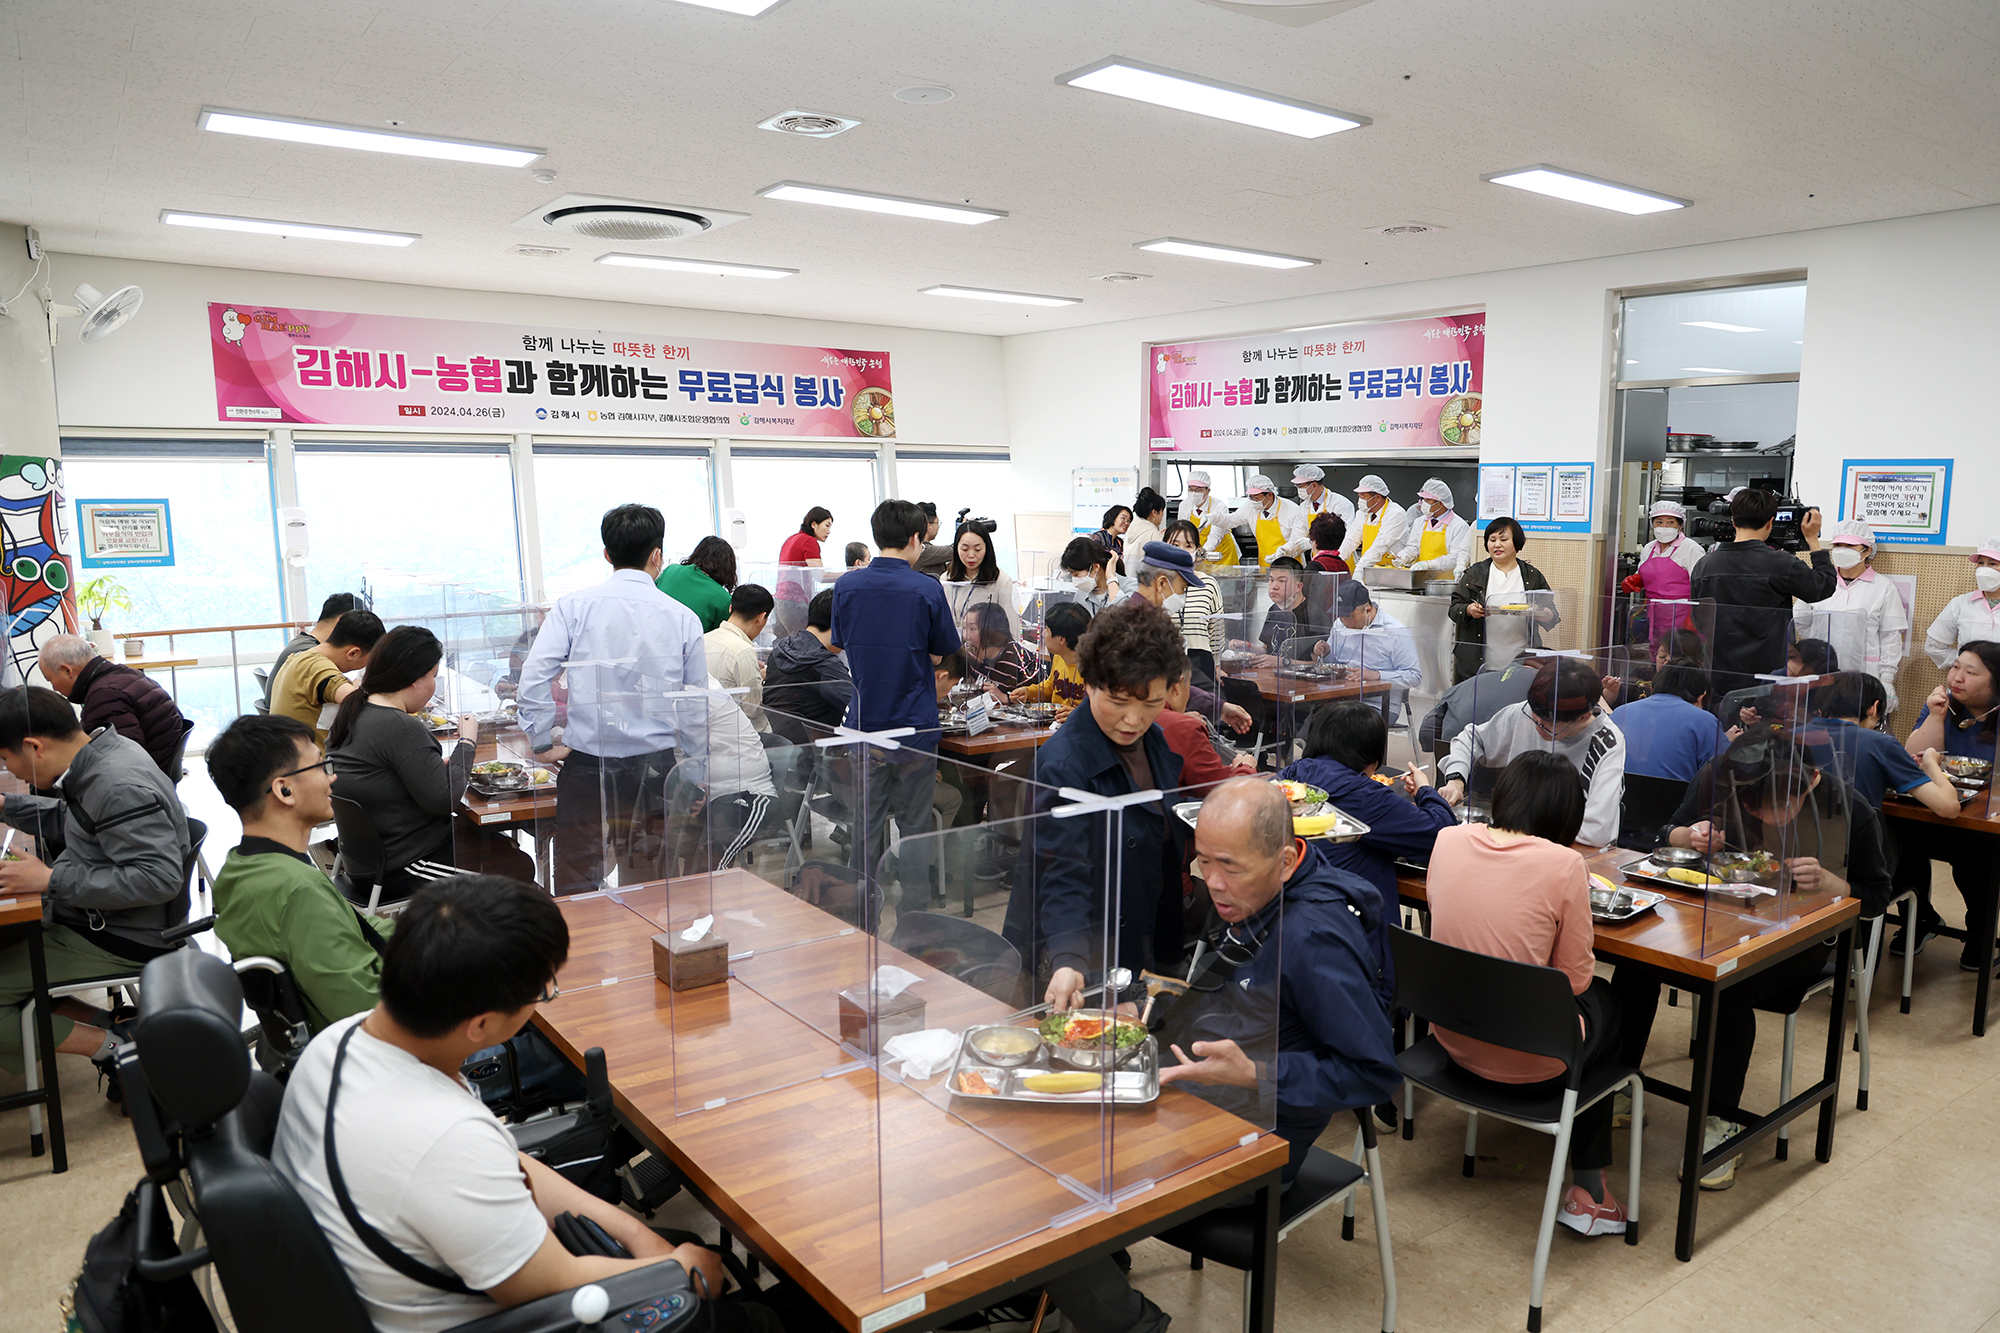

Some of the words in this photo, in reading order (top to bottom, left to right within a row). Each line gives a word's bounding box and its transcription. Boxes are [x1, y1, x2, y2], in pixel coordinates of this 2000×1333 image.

[253, 314, 279, 325] GIM
[1442, 324, 1472, 343] 대한민국
[521, 334, 554, 353] 함께
[560, 337, 606, 356] 나누는
[612, 342, 656, 359] 따뜻한
[662, 344, 691, 361] 한끼
[1241, 350, 1263, 363] 함께
[1266, 346, 1299, 361] 나누는
[1303, 342, 1337, 358] 따뜻한
[1342, 339, 1366, 355] 한끼
[820, 353, 840, 369] 새로운
[840, 355, 869, 373] 대한민국
[868, 358, 883, 370] 농협
[294, 347, 538, 396] 김해시-농협과
[545, 359, 669, 401] 함께하는
[677, 368, 786, 407] 무료급식
[792, 375, 845, 409] 봉사
[1170, 377, 1271, 410] 김해시-농협과
[1274, 372, 1342, 405] 함께하는
[1348, 366, 1423, 400] 무료급식
[1429, 362, 1472, 397] 봉사
[403, 406, 422, 415] 일시
[430, 406, 506, 419] 2024.04.26(금)
[550, 409, 580, 420] 김해시
[600, 411, 615, 421] 농협
[753, 416, 796, 426] 김해시복지재단
[1213, 427, 1249, 437] 2024.04.26(금)
[1261, 427, 1278, 436] 김해시
[1863, 484, 1886, 492] 반찬이
[1904, 484, 1928, 492] 드시기
[1897, 501, 1920, 509] 있으니
